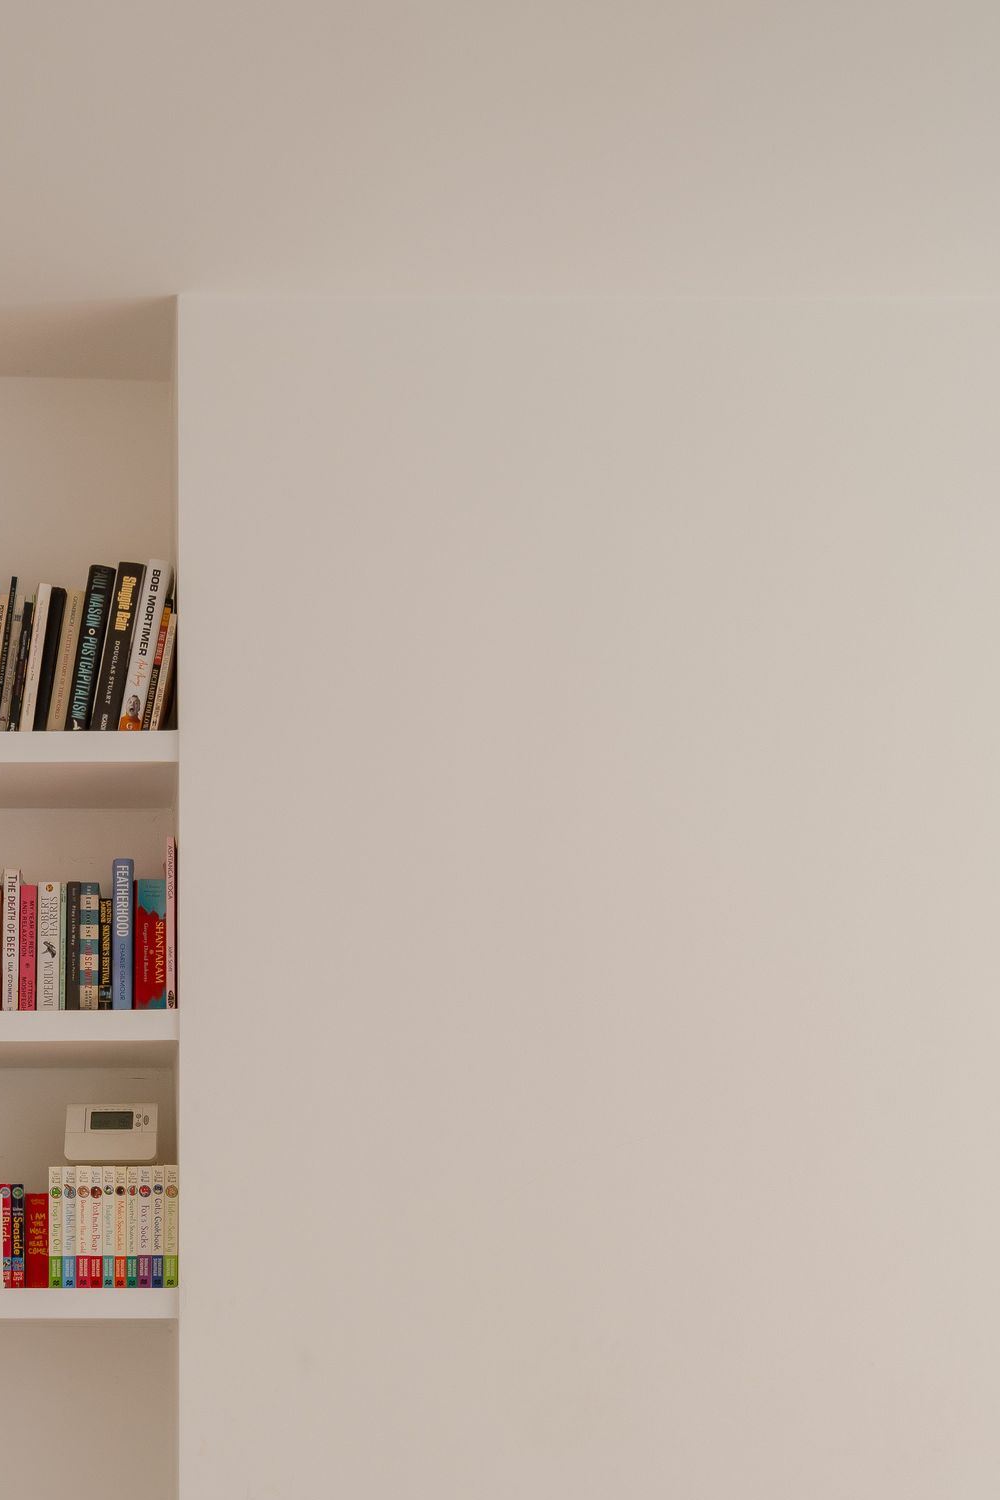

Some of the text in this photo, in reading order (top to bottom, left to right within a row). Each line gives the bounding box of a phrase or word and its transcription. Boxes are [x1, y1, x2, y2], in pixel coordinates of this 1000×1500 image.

[114, 576, 137, 631] Shuggie Bain
[138, 569, 161, 656] BOB MORTIMER
[71, 567, 107, 721] PAUL MASON POSTCAPITALISM
[105, 641, 121, 704] DOUGLAS STUART
[155, 643, 164, 660] BIBLE
[7, 875, 18, 958] THE DEATH OF BEES
[41, 896, 49, 937] ROBERT
[116, 865, 129, 937] FEATHERHOOD
[102, 924, 110, 984] SKINNER'S FESTIVAL
[155, 921, 164, 983] SHANTARAM
[43, 961, 53, 1007] IMPERIUM
[13, 1217, 23, 1255] Seaside
